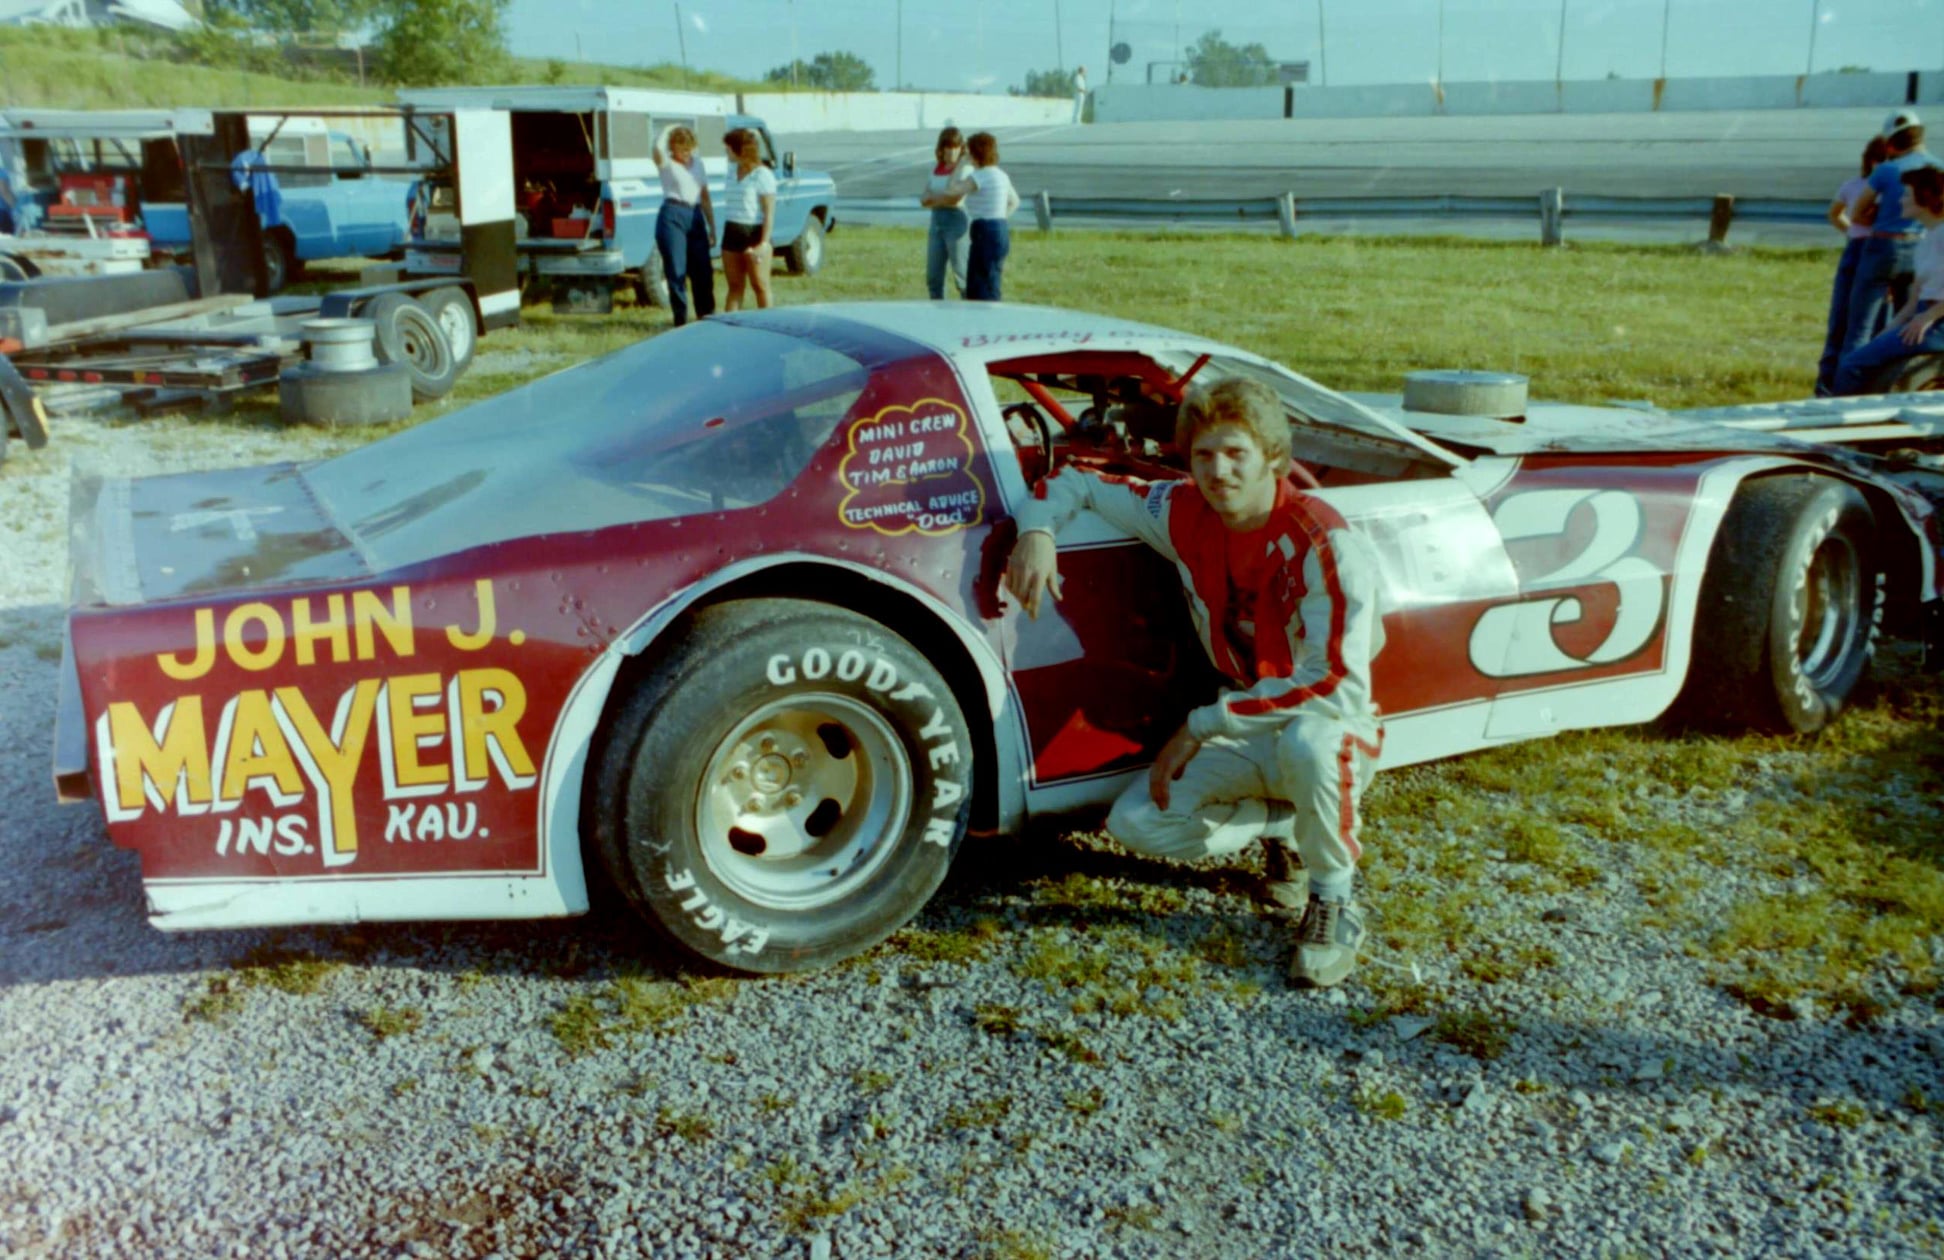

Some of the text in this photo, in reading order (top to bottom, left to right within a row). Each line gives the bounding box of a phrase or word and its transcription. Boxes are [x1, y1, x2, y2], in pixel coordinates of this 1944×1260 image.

[859, 413, 956, 444] MINI CREW
[869, 442, 925, 464] DAVID
[849, 469, 890, 486] TIM
[910, 458, 958, 476] AARON
[845, 490, 978, 521] TECHNICAL ADVICE
[1468, 489, 1667, 679] 3
[157, 578, 525, 679] JOHN J.
[96, 667, 536, 867] MAYER
[767, 648, 962, 848] GOODYEAR
[216, 814, 314, 856] INS.
[666, 868, 769, 954] EAGLE
